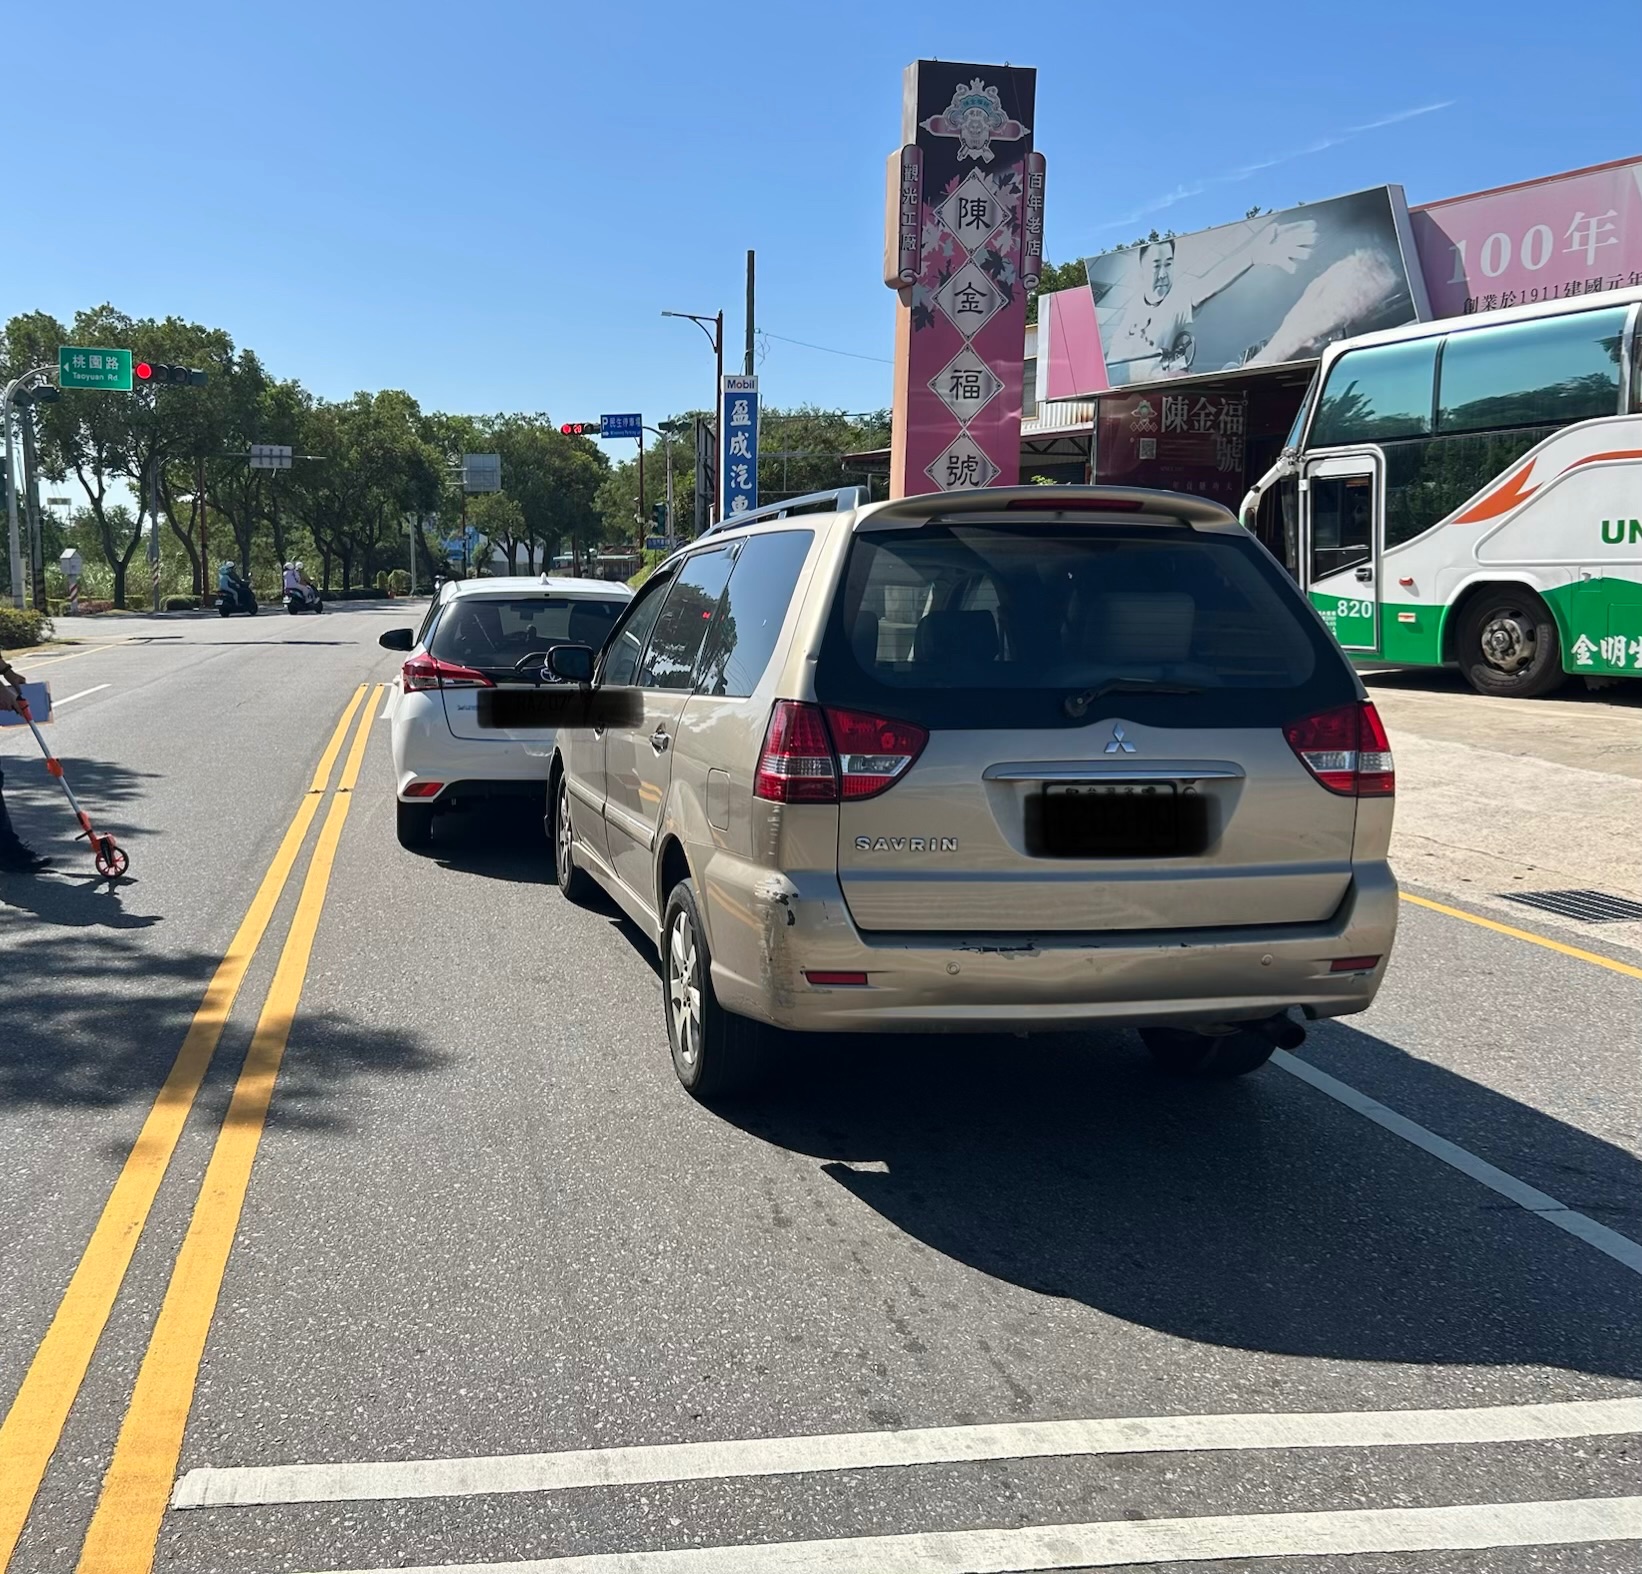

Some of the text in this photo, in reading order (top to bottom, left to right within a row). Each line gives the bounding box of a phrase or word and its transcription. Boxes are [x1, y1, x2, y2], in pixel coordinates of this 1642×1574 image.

[901, 164, 918, 250] 觀光工廠
[1025, 171, 1043, 258] 百年老店
[1447, 209, 1619, 284] 100年
[72, 354, 119, 371] 桃園路
[945, 197, 991, 487] 陳金福號
[72, 372, 105, 382] Taoyuan
[727, 379, 755, 390] Mobil
[729, 399, 752, 517] 盈成汽車
[1337, 600, 1373, 618] 820
[855, 835, 959, 853] SAVRIN
